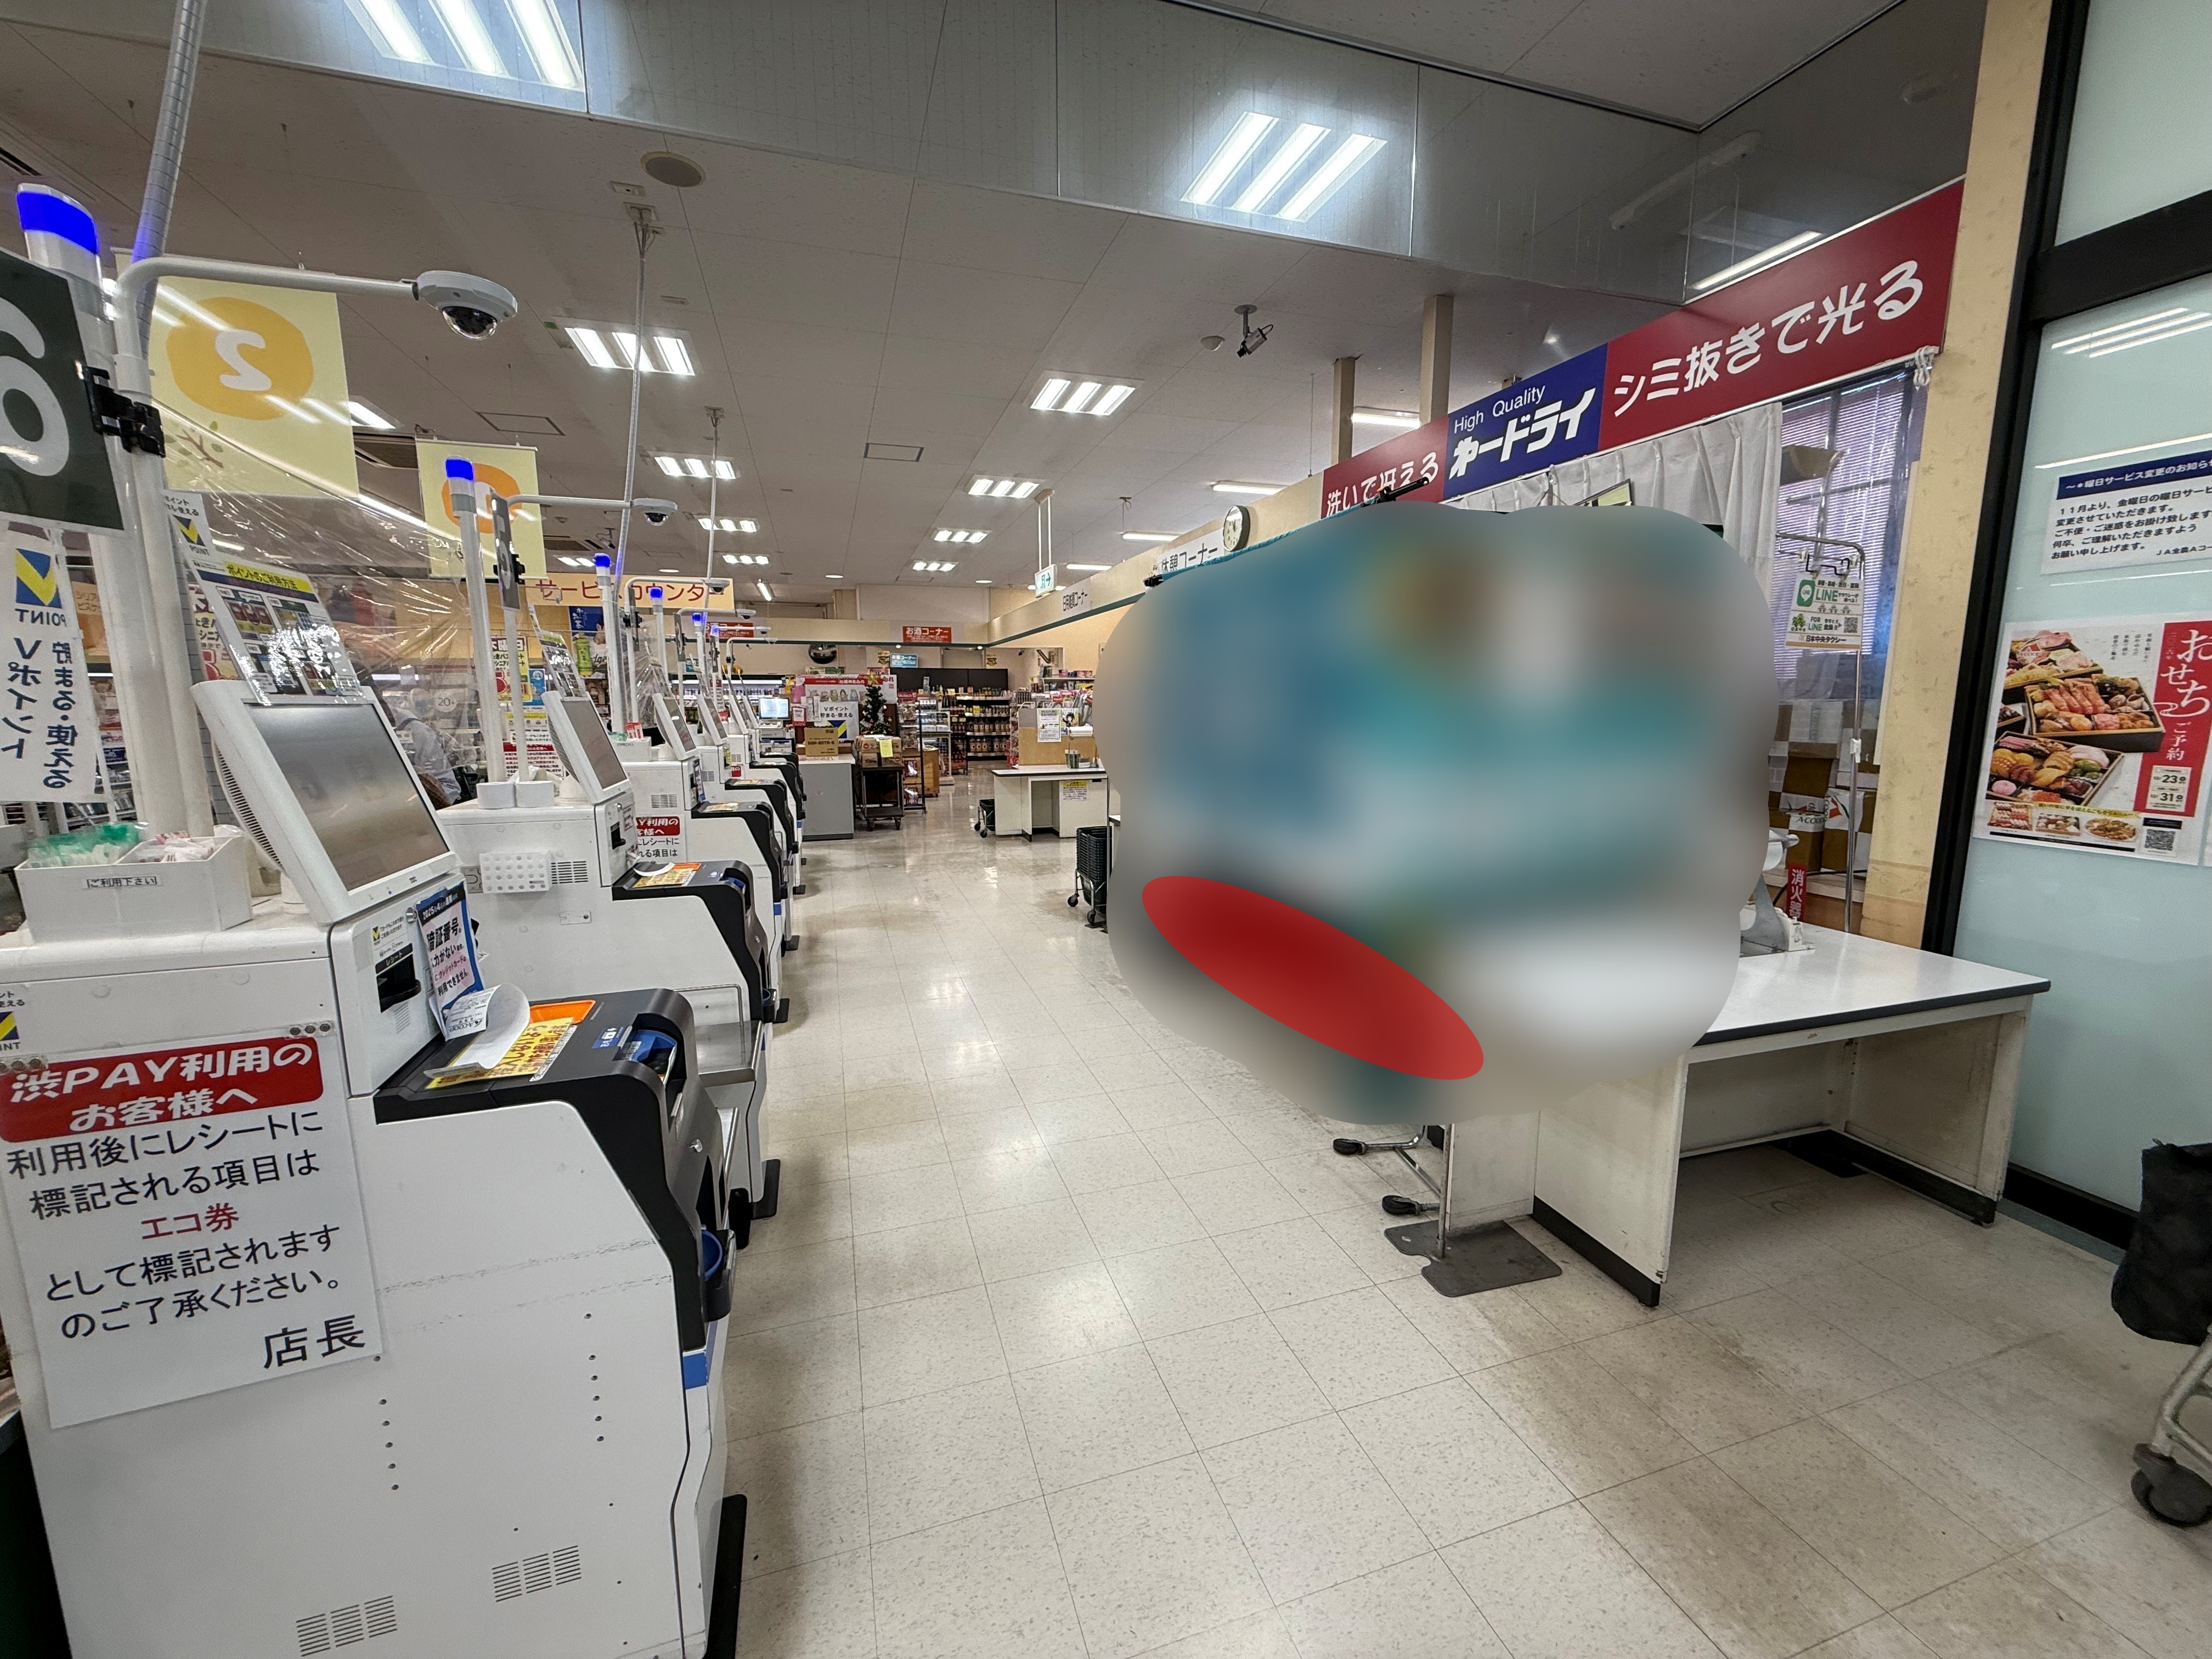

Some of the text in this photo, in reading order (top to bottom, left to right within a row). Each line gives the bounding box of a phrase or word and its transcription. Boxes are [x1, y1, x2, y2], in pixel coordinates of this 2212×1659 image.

[1614, 260, 1925, 417] シミ抜きで光る
[1454, 386, 1546, 434] High Quality
[1815, 589, 1838, 602] LINE
[905, 627, 949, 635] お酒コーナー
[1805, 635, 1847, 643] 日本中央タクシー
[437, 697, 456, 707] 20+
[2166, 721, 2192, 761] ご予約
[89, 876, 156, 888] ご利用下さい
[1789, 868, 1805, 919] 消火器
[386, 951, 403, 966] レシート
[10, 1043, 313, 1103] 渋PAY利用の
[69, 1087, 258, 1132] お客様へ
[7, 1110, 324, 1180] 利用後にレシートに
[29, 1148, 321, 1221] 標記される項目は
[140, 1202, 240, 1240] エコ券
[46, 1223, 340, 1302] として標記されます
[61, 1269, 340, 1339] のご了承ください。
[263, 1314, 365, 1370] 店長
